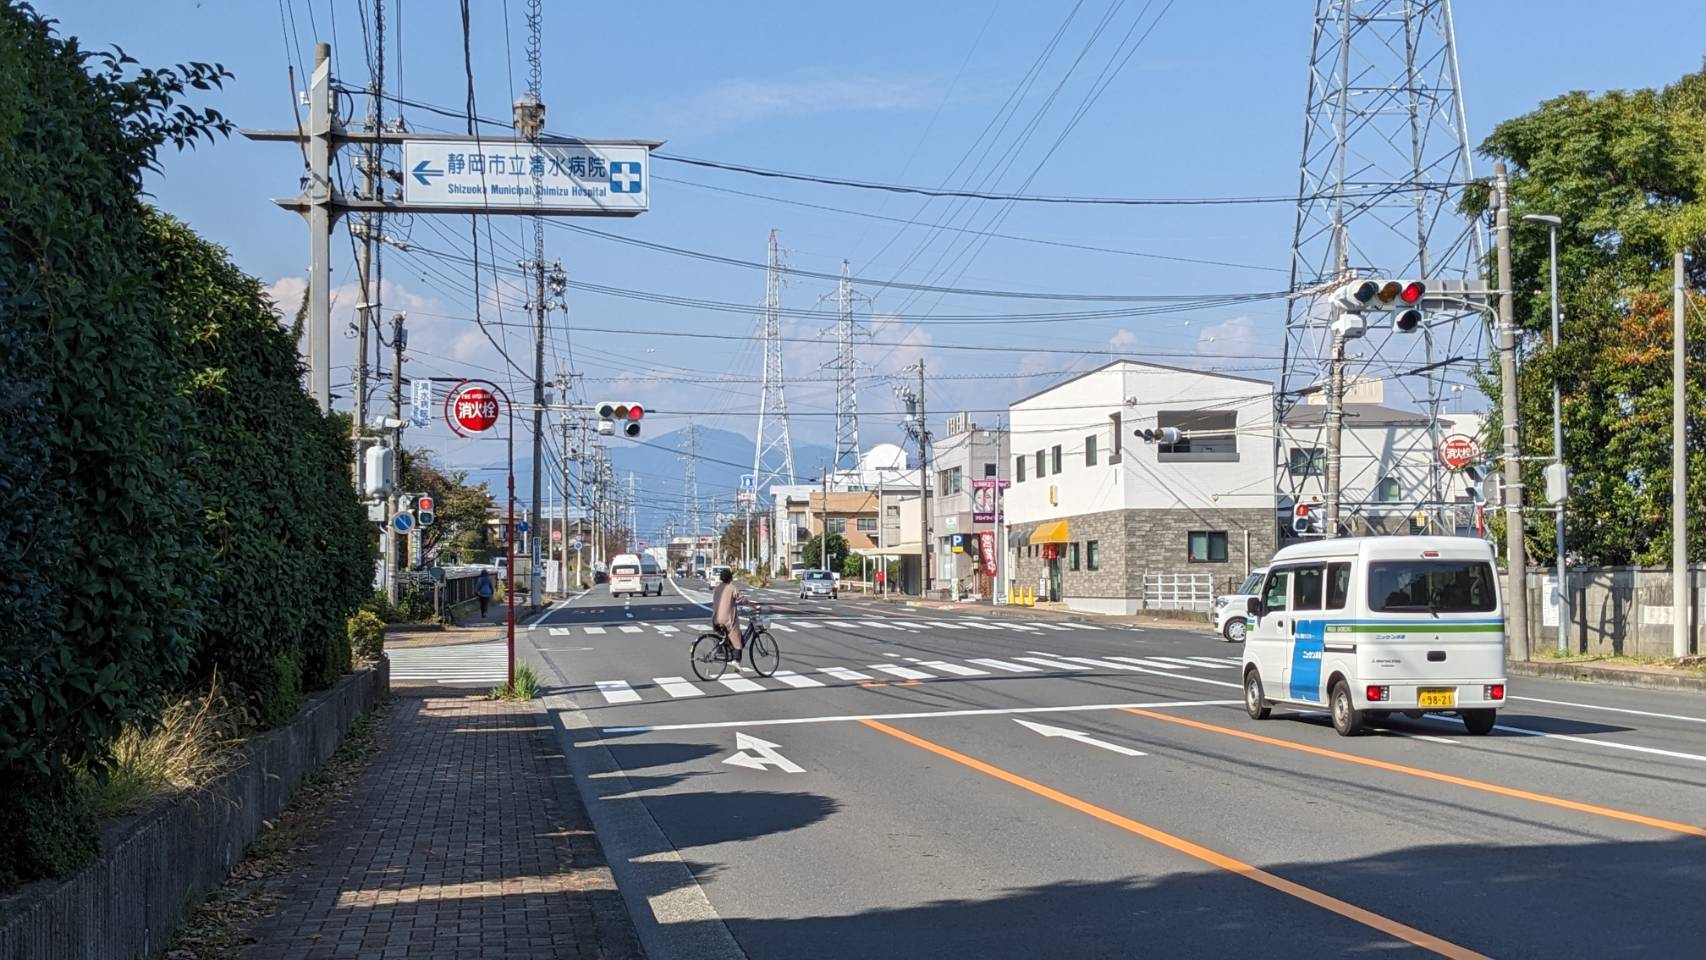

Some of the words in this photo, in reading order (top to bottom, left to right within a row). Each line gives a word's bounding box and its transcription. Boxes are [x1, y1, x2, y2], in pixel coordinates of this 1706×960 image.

[447, 153, 606, 178] 静岡市立清水病院
[491, 184, 532, 195] Municipal
[536, 185, 569, 196] Shimizu
[571, 186, 607, 198] Hospital
[458, 401, 496, 419] 消火栓
[1446, 447, 1470, 459] 消火栓
[953, 536, 962, 546] P
